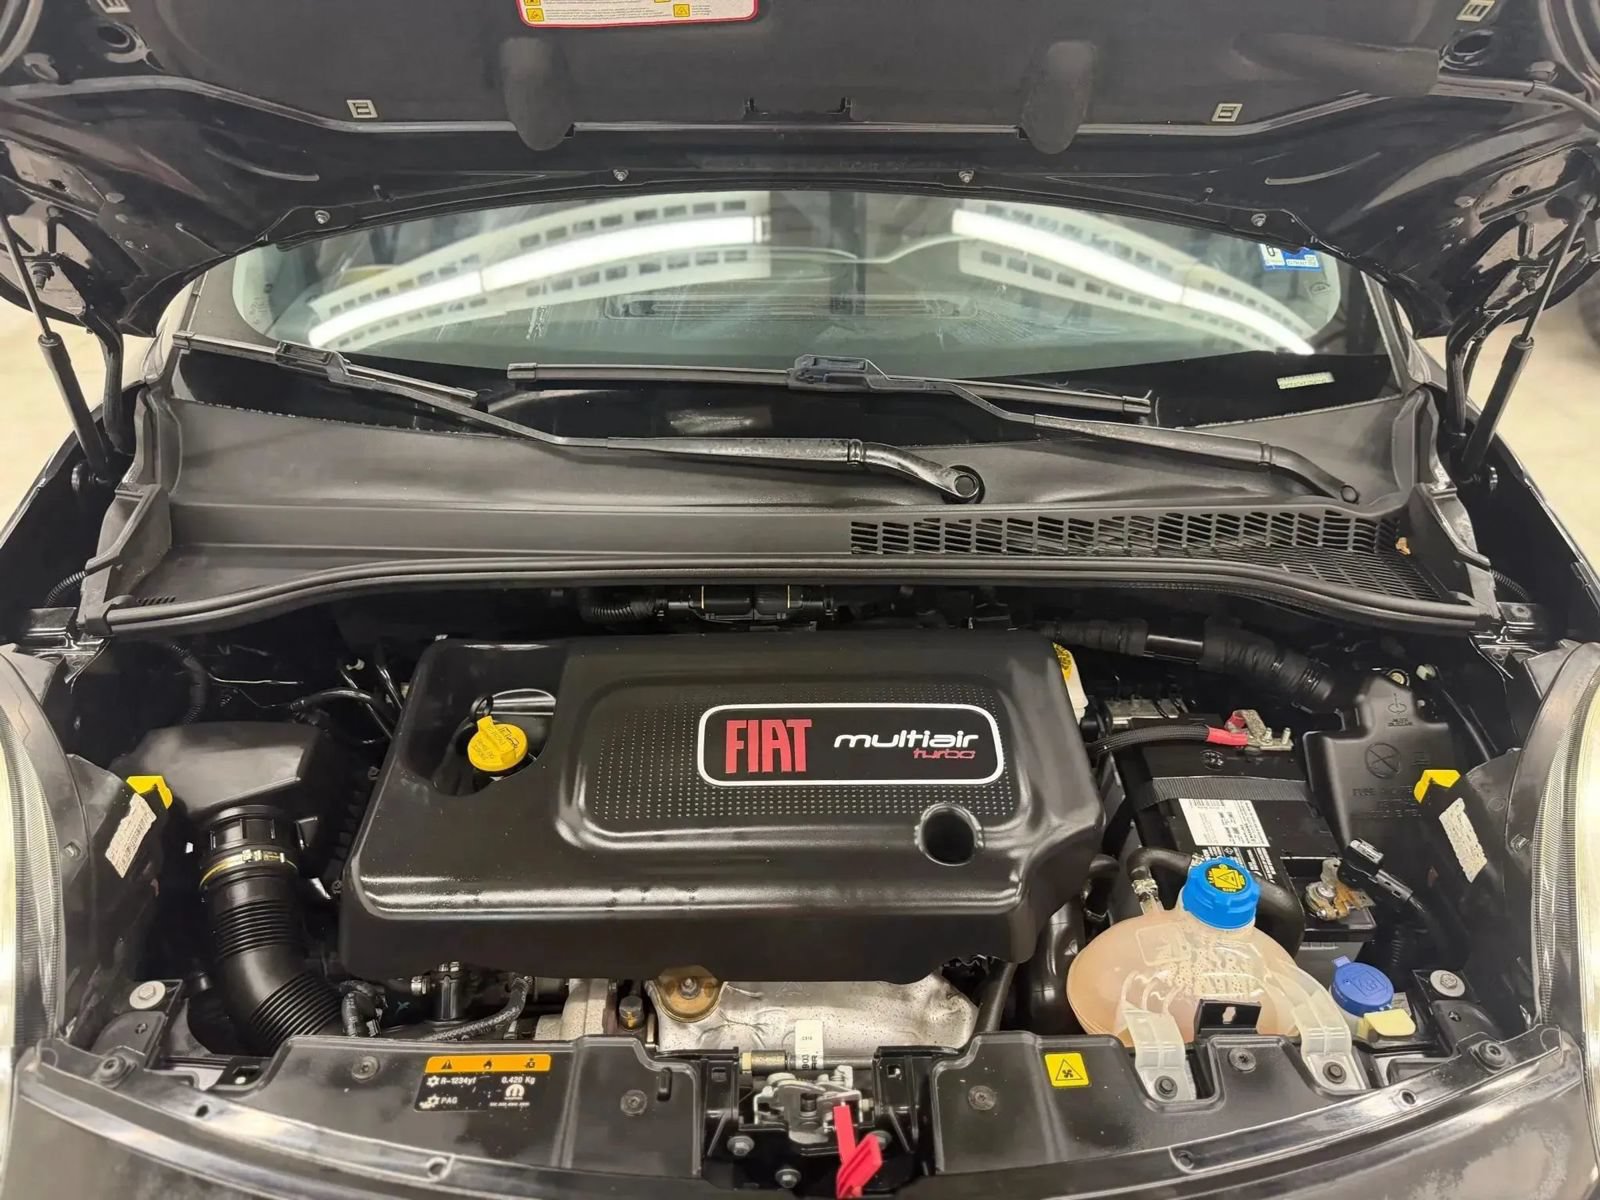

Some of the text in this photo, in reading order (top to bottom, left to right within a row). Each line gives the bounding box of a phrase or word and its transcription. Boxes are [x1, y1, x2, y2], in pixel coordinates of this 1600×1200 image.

[833, 730, 979, 748] multiair
[725, 719, 812, 773] FIAT
[913, 748, 976, 759] turbo
[440, 1076, 477, 1086] R-1234yf
[501, 1076, 536, 1086] 0.420 Kg
[440, 1096, 458, 1104] PAG
